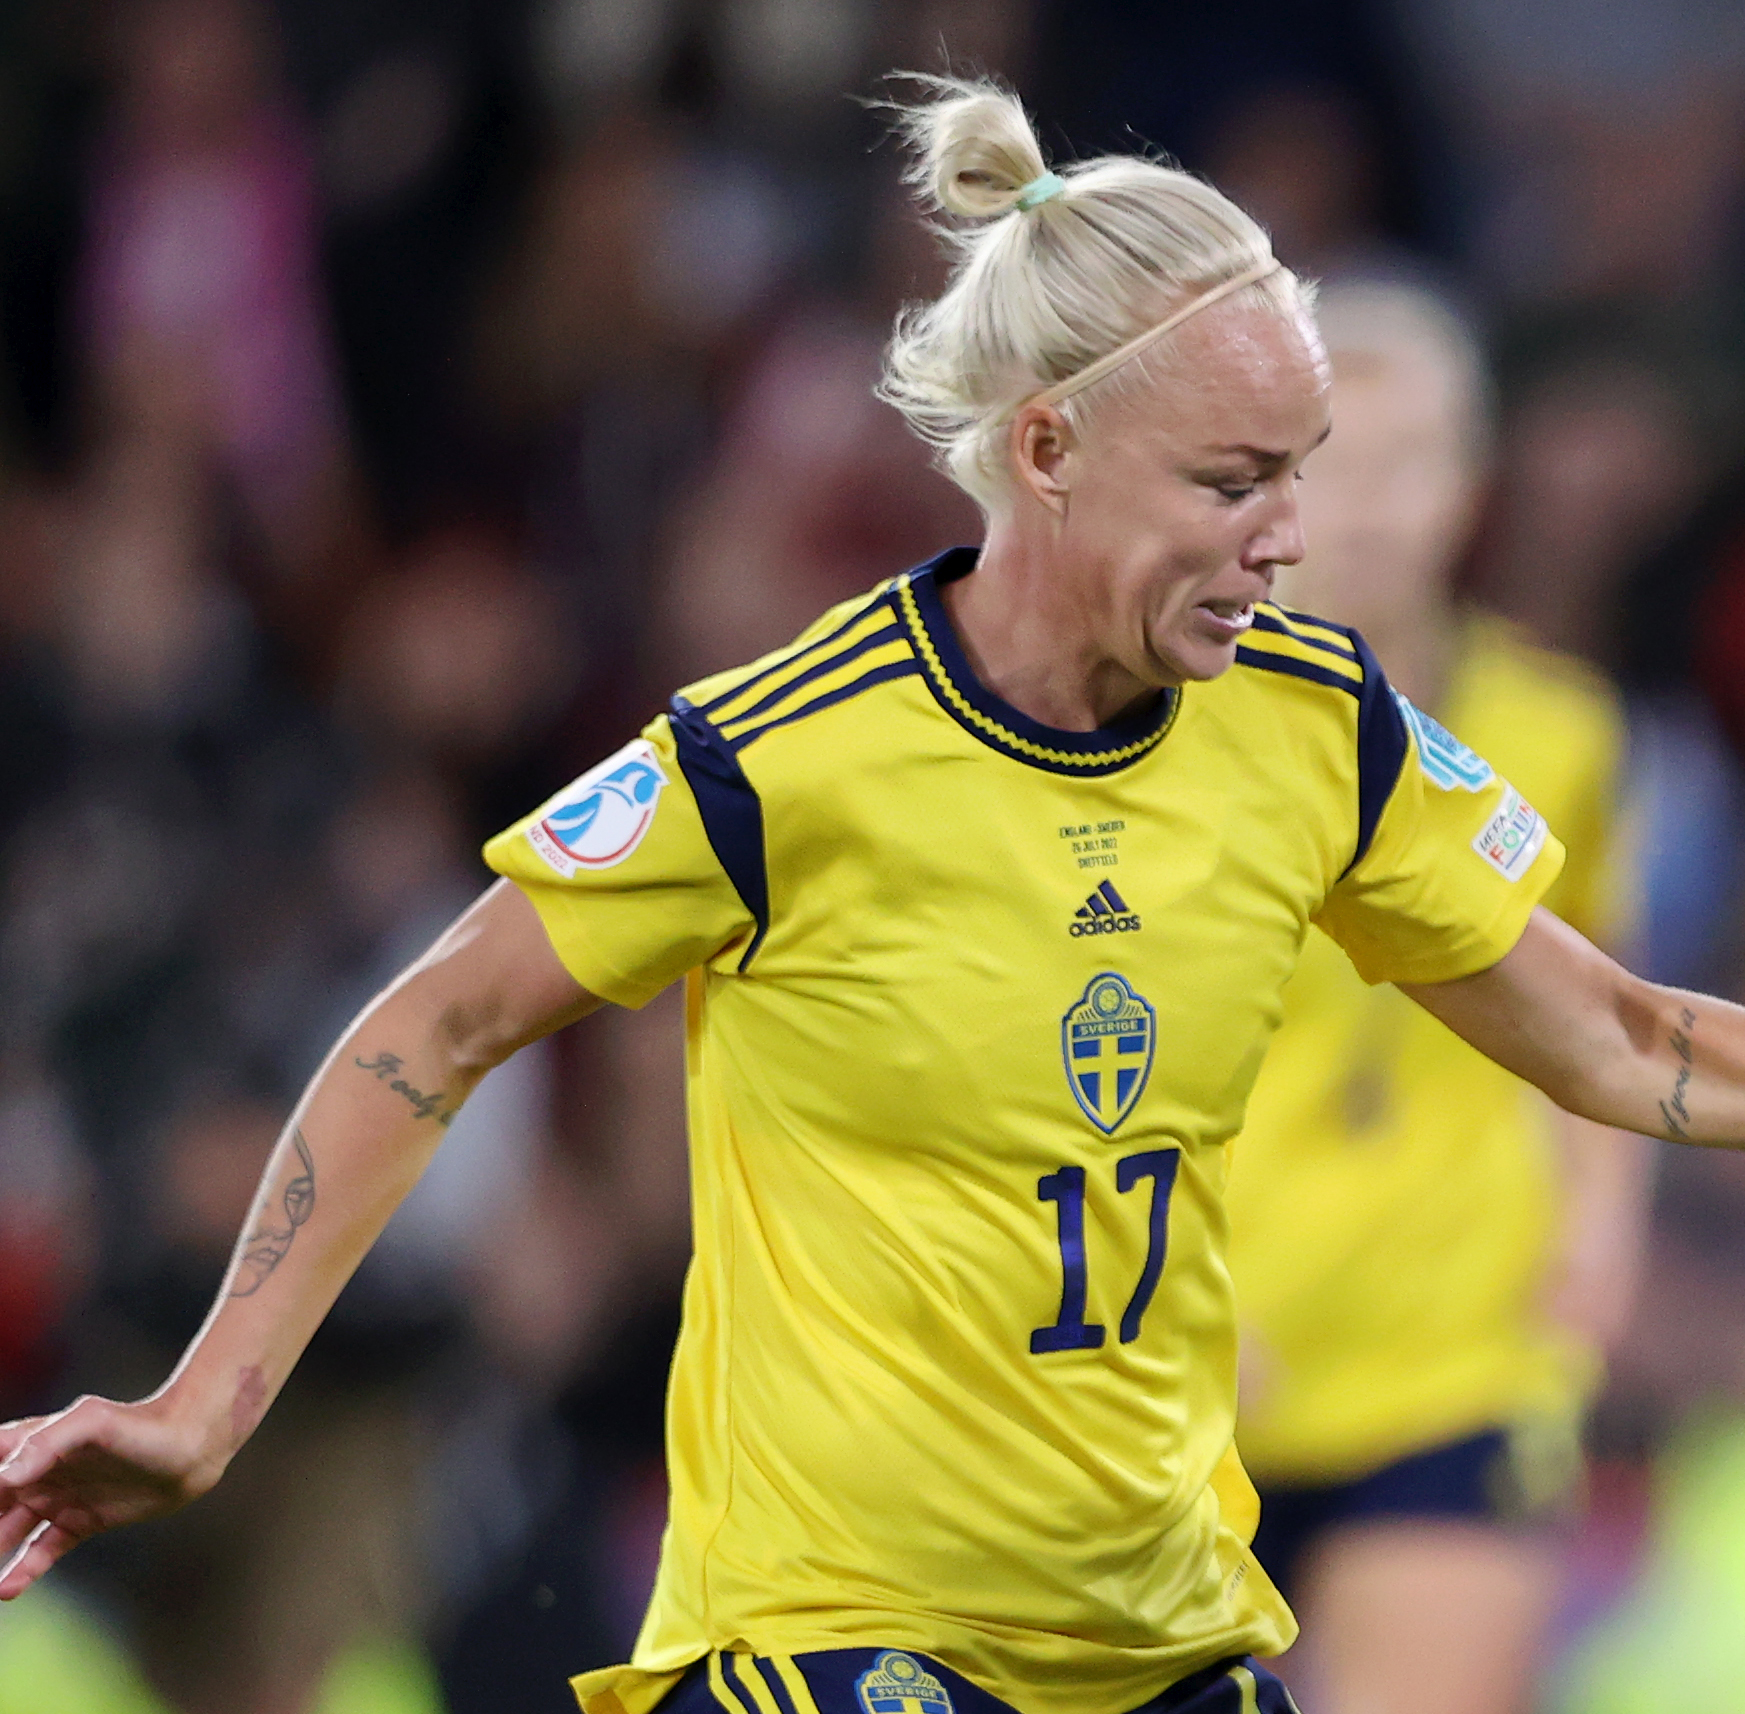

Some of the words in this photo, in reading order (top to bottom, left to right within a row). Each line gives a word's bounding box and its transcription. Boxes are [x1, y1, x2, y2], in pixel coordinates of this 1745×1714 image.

[1478, 814, 1508, 852] UEFA
[1069, 914, 1141, 937] adidas
[1080, 1019, 1139, 1036] SVERIGE
[1030, 1148, 1181, 1354] 17
